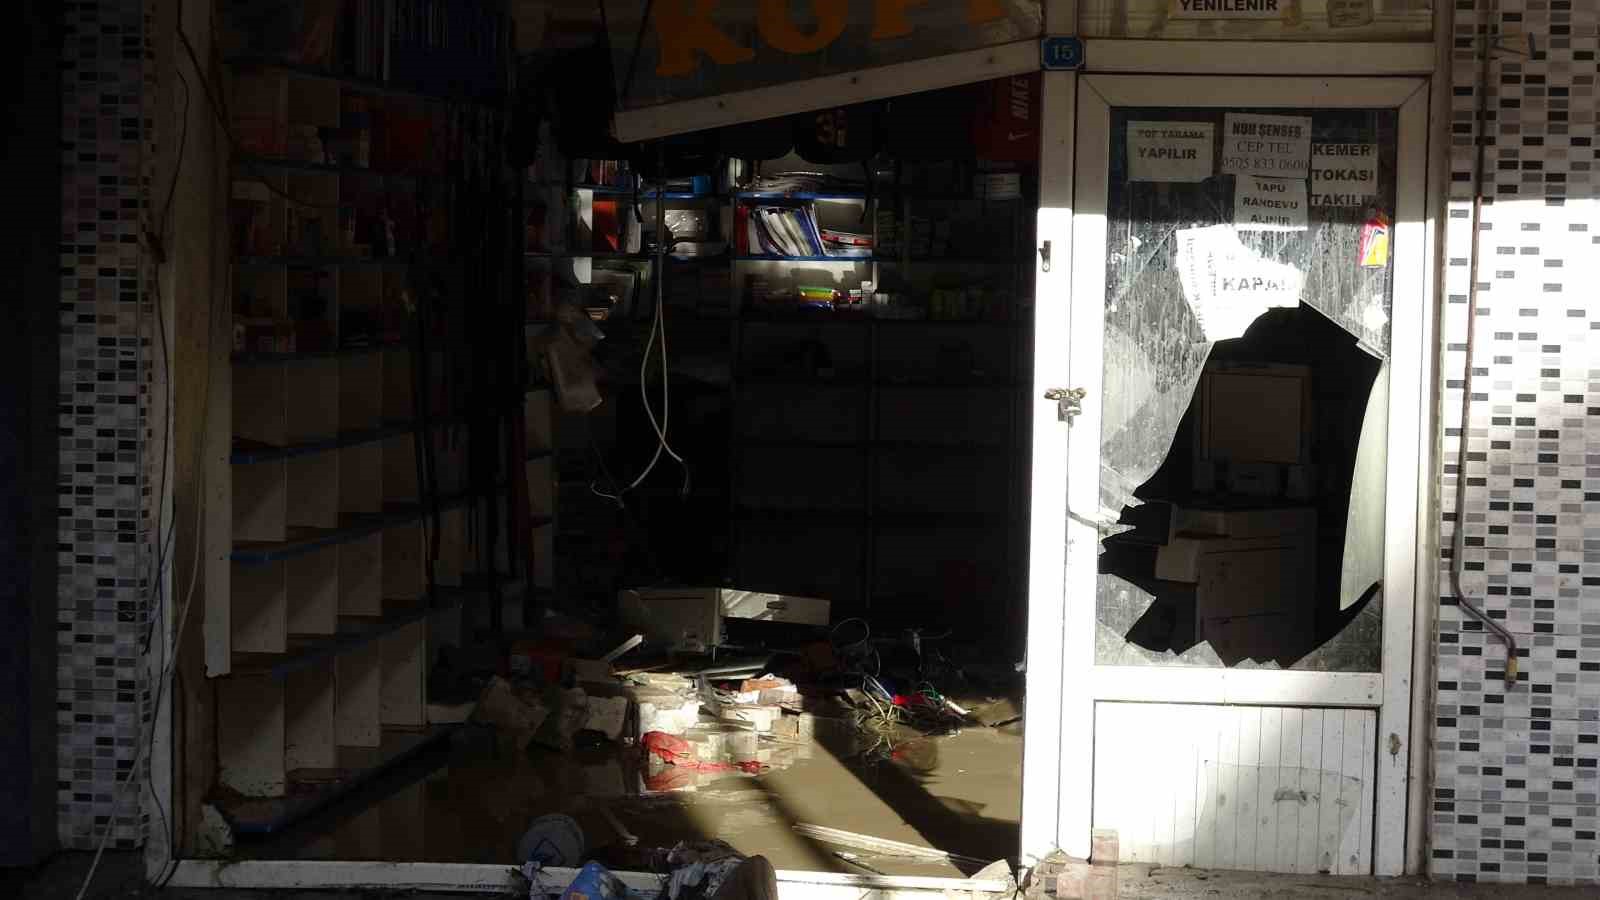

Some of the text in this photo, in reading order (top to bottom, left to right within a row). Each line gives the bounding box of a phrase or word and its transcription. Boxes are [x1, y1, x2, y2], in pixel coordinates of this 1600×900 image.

[1054, 44, 1073, 60] 15
[1138, 147, 1197, 160] YAPILIR
[1236, 140, 1293, 154] CEP TEL
[1312, 144, 1371, 156] KEMER
[1312, 169, 1374, 181] TOKASI
[1255, 183, 1285, 193] TAPU
[1243, 197, 1298, 210] RANDEVU
